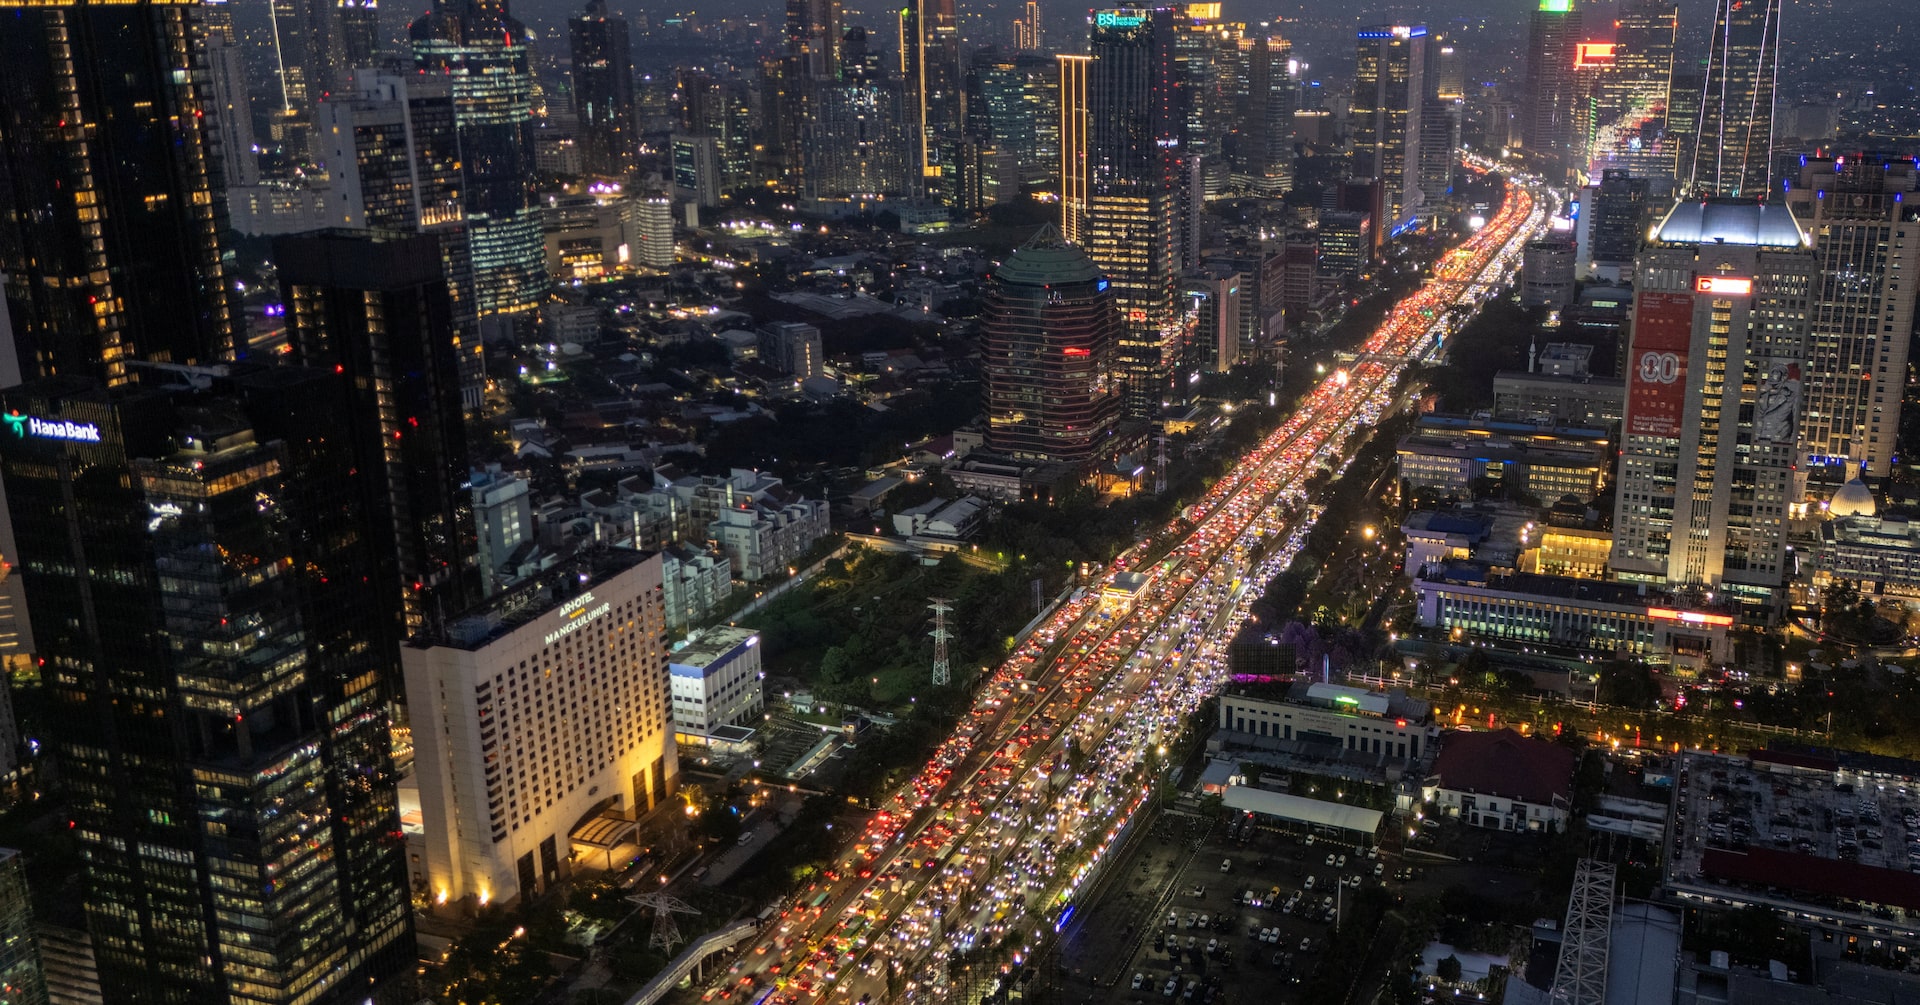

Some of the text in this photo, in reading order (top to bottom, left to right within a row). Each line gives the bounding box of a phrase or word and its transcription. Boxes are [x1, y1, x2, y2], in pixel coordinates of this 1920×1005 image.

[1098, 13, 1116, 26] BSI
[1639, 351, 1679, 384] 80
[545, 602, 610, 645] MANGKULUHUR
